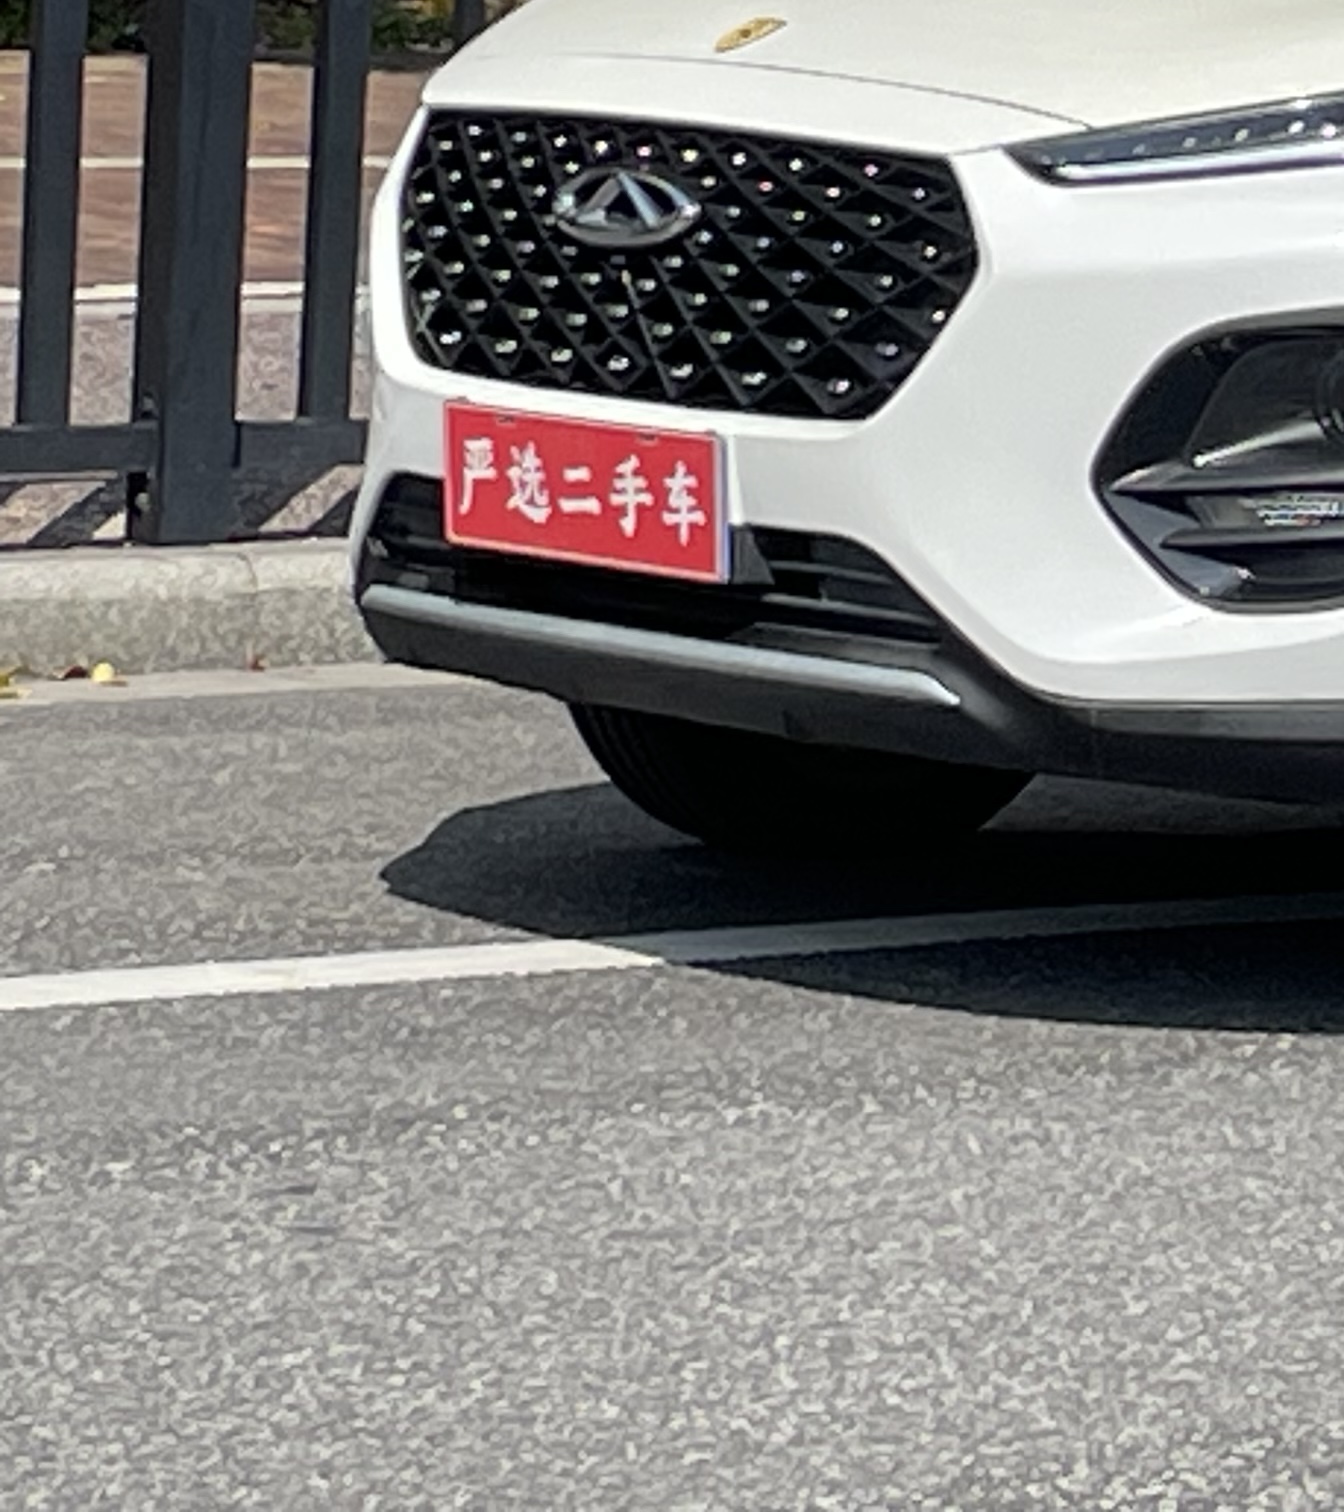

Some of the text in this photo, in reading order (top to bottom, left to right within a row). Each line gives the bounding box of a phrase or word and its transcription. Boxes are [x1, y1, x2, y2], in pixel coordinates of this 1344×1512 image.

[458, 436, 706, 546] 严选二手车
